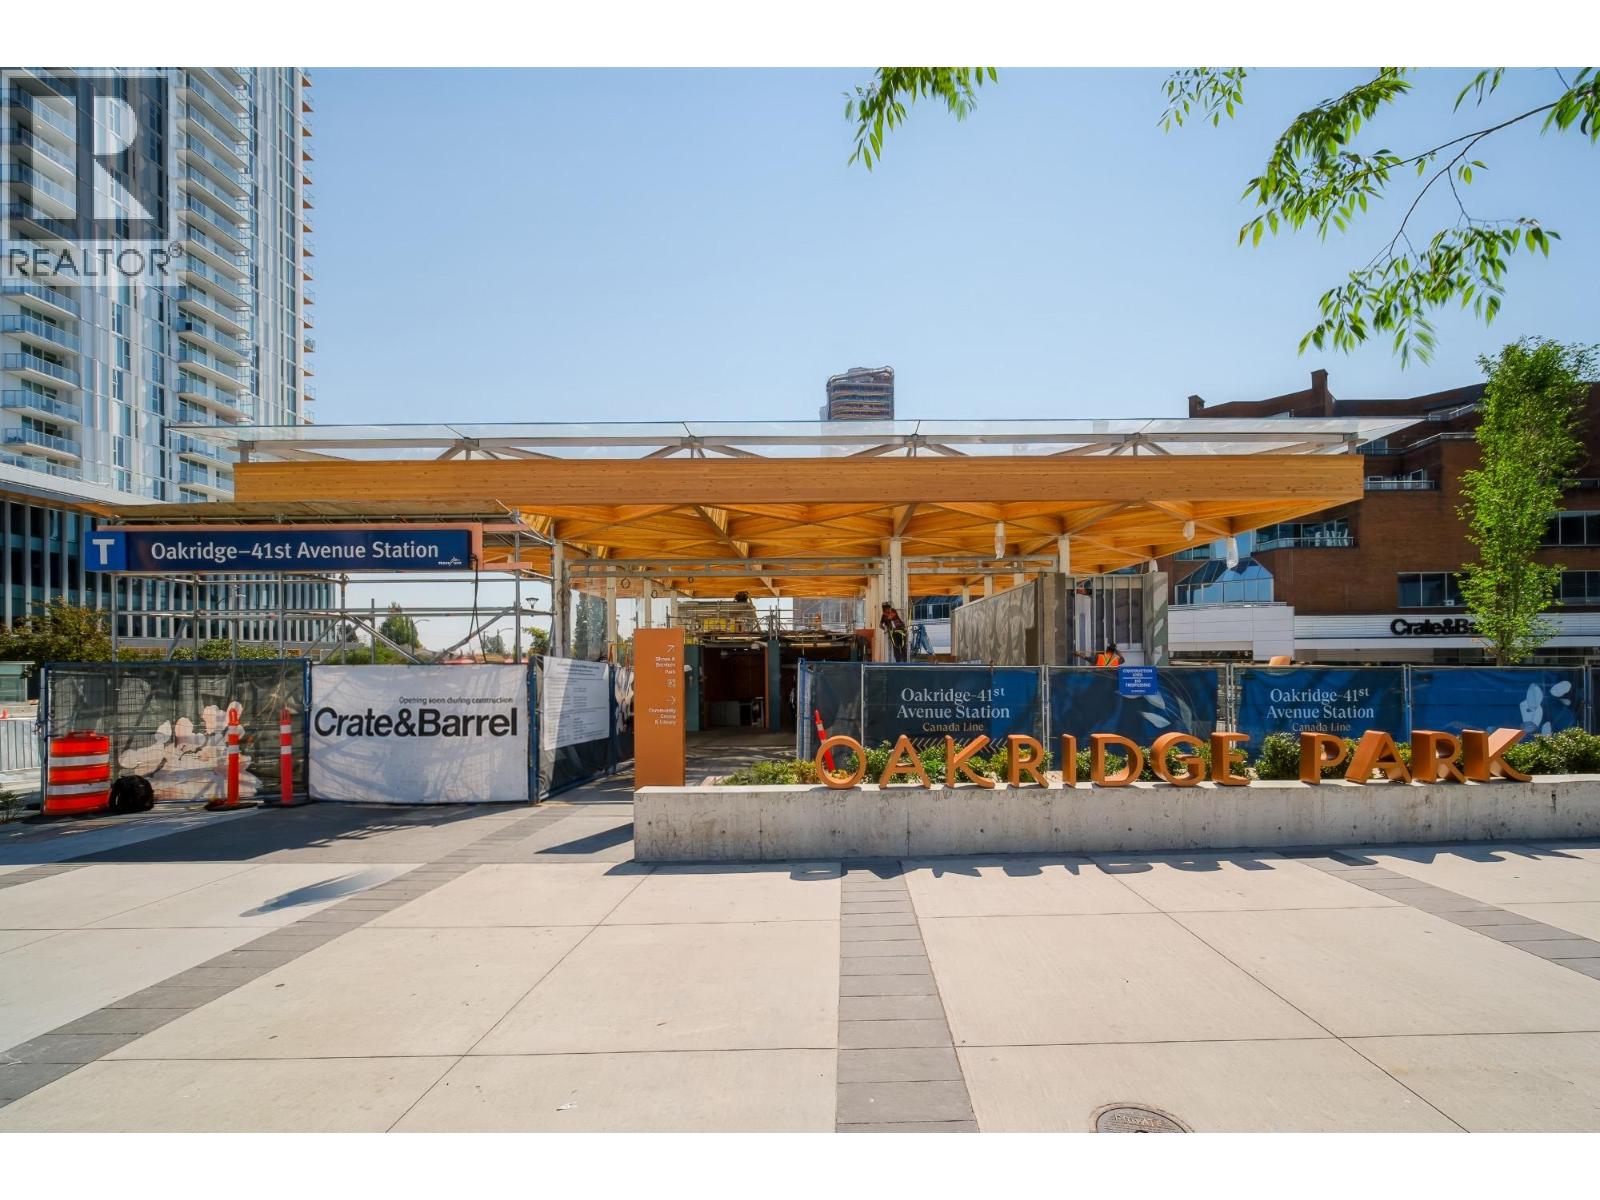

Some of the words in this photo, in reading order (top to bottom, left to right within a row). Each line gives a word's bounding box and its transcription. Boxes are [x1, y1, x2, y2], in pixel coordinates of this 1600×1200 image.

[92, 538, 115, 565] T
[296, 541, 366, 559] Avenue
[372, 540, 439, 559] Station
[399, 696, 427, 706] Opening
[447, 696, 471, 706] during
[472, 696, 513, 704] construction
[897, 705, 952, 719] Avenue
[955, 704, 1010, 719] Station
[1266, 705, 1320, 719] Avenue
[1323, 704, 1375, 719] Station
[314, 706, 518, 738] Crate&Barrel
[922, 722, 960, 732] Canada
[963, 722, 985, 732] Line
[1292, 722, 1328, 732] Canada
[1331, 722, 1351, 732] Line
[815, 731, 1251, 790] OAKRIDGE
[1300, 728, 1533, 786] PARK
